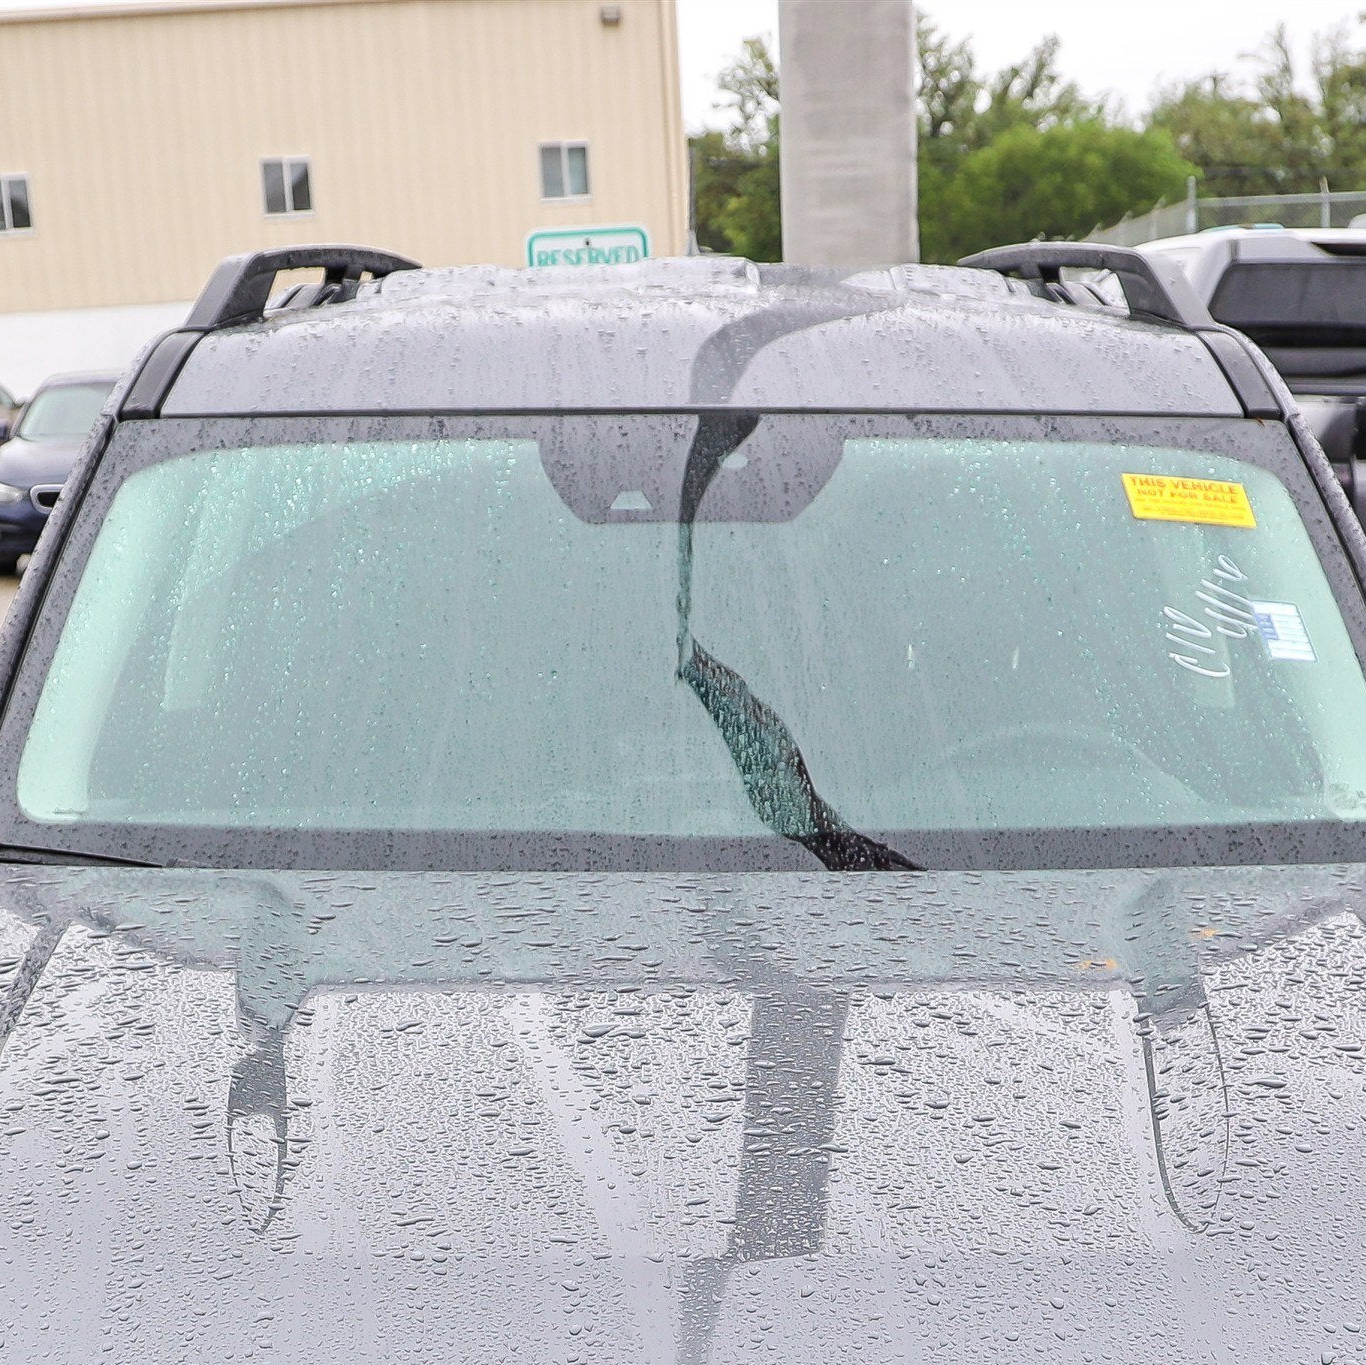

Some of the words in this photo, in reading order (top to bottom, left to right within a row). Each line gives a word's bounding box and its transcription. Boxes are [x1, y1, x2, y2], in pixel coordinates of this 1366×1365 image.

[537, 245, 640, 267] RESERVED
[1130, 477, 1166, 488] THIS
[1170, 479, 1238, 494] VEHICLE
[1137, 488, 1164, 497] NOT
[1170, 490, 1198, 501] FOR
[1204, 492, 1238, 504] SALE
